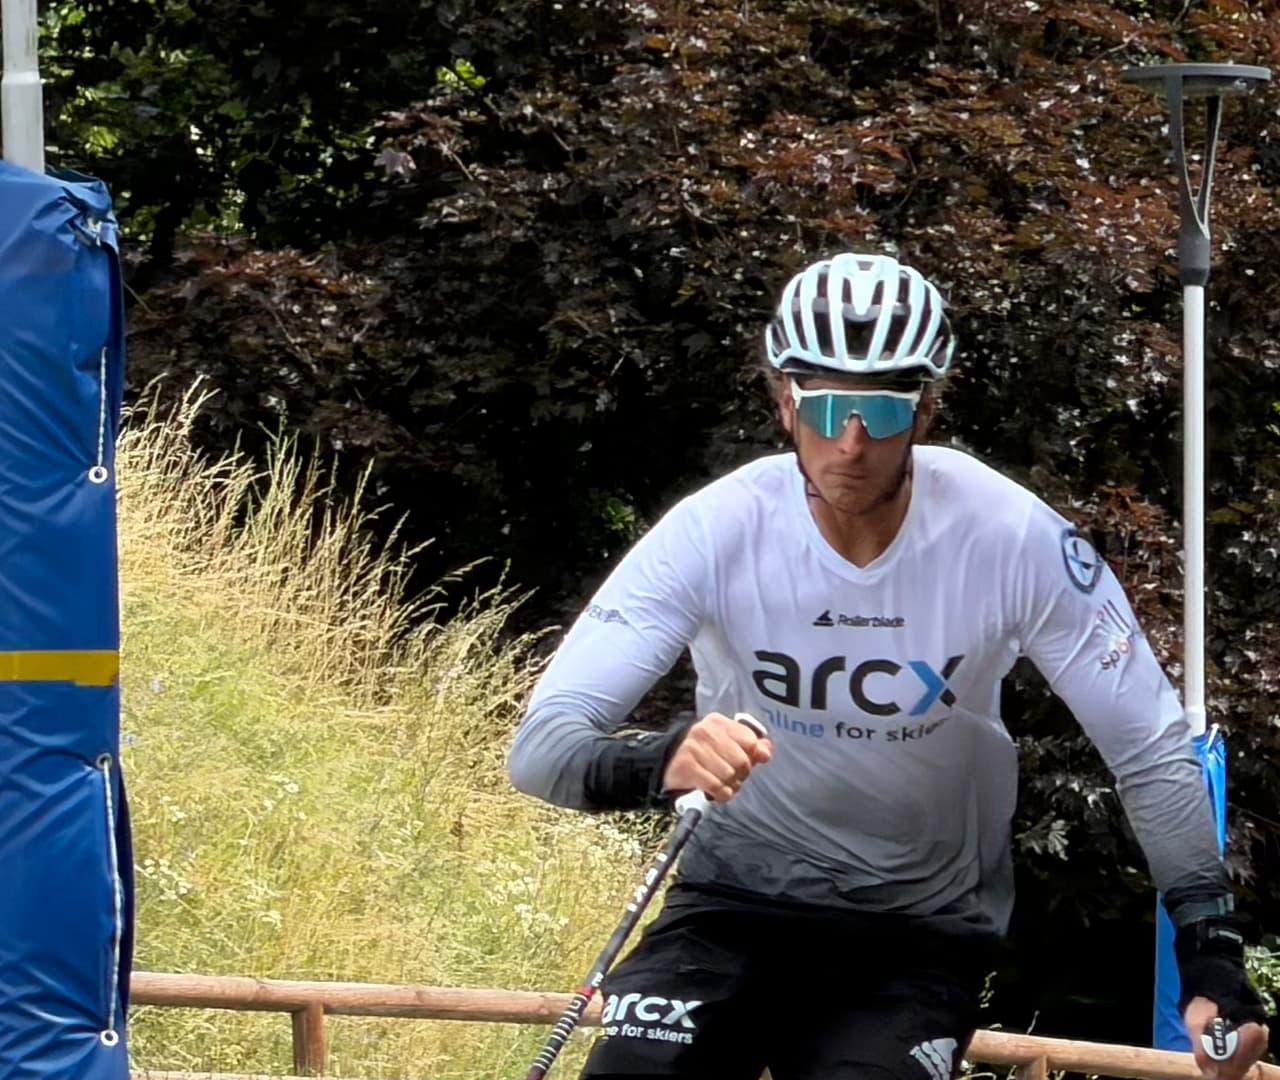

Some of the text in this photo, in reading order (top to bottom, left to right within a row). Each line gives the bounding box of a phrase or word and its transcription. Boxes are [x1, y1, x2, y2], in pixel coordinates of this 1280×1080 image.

[752, 650, 965, 716] arcx
[834, 721, 877, 740] for
[602, 993, 703, 1028] arcx
[621, 1023, 645, 1038] for
[646, 1027, 694, 1044] skiers
